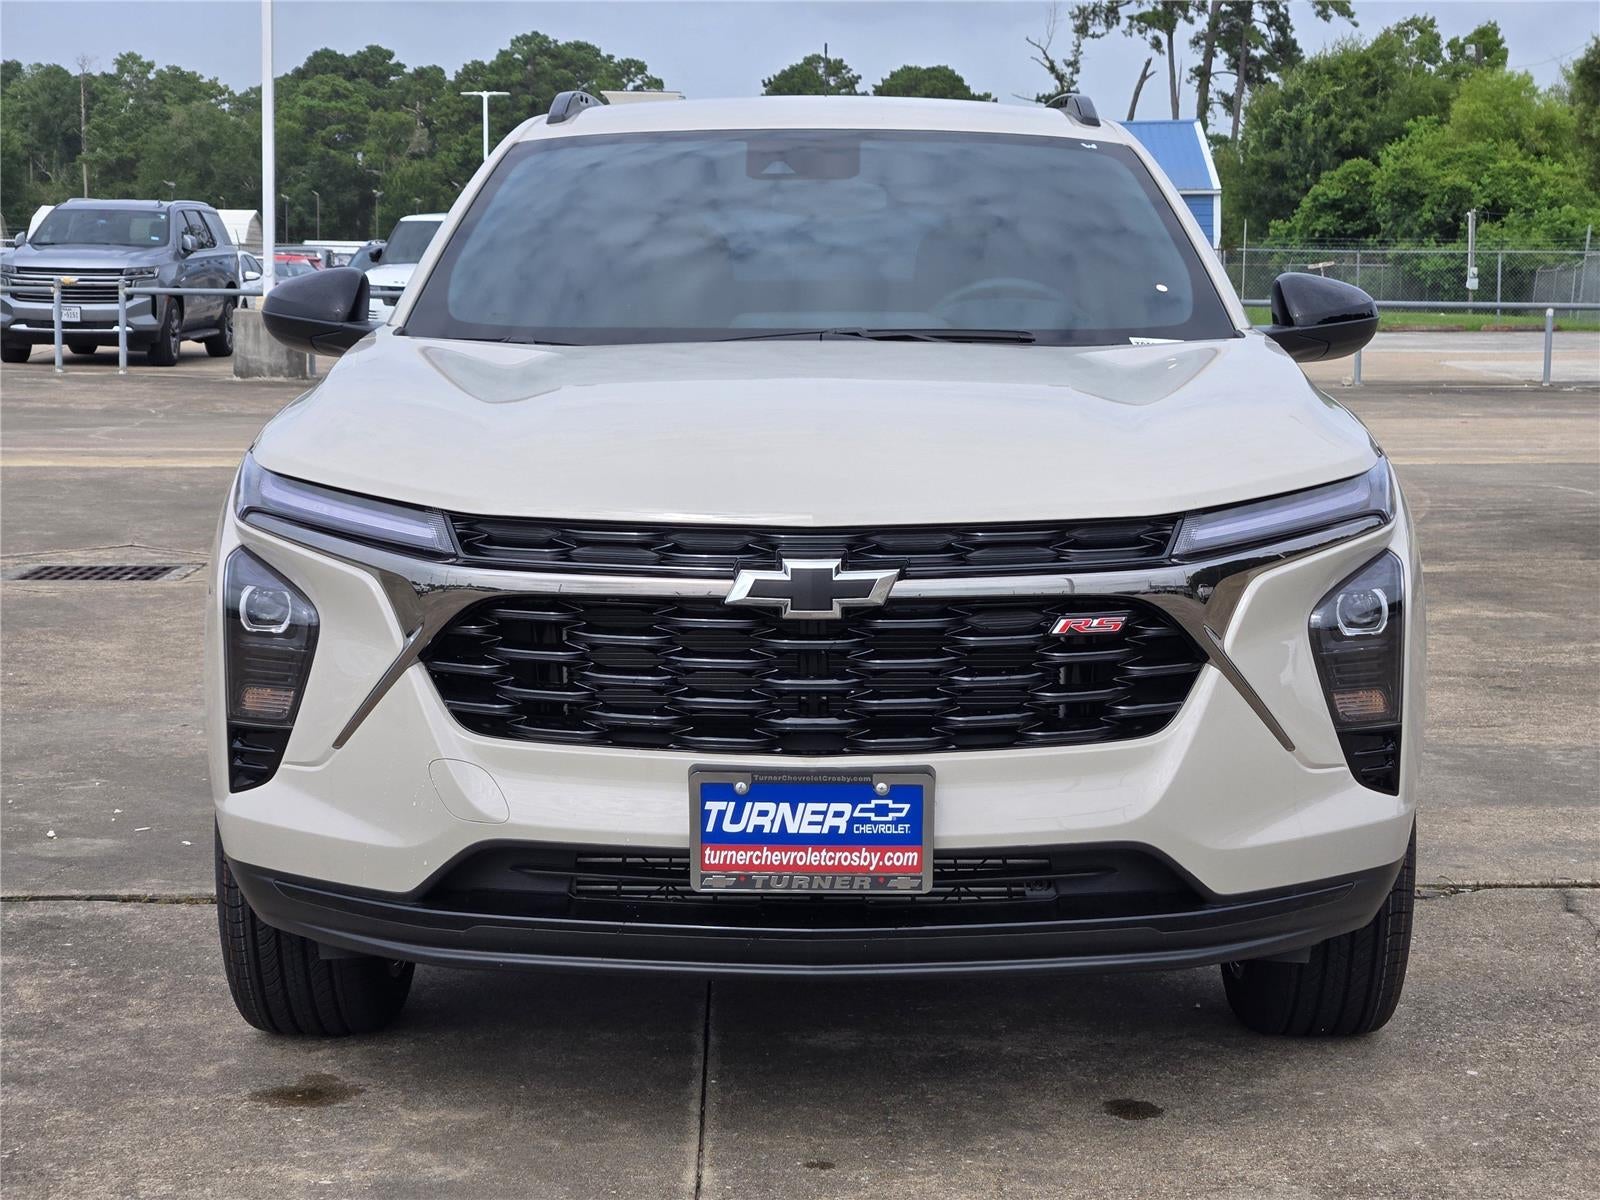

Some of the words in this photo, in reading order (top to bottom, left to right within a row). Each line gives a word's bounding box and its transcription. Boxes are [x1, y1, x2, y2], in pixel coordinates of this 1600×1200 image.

[1051, 616, 1126, 634] RS
[753, 774, 872, 783] TurnerChevroletCrosby.com
[704, 801, 853, 835] TURNER
[853, 823, 910, 834] CHEVROLET
[704, 846, 918, 871] turnerchevroletcrosby.com
[751, 875, 871, 890] TURNER
